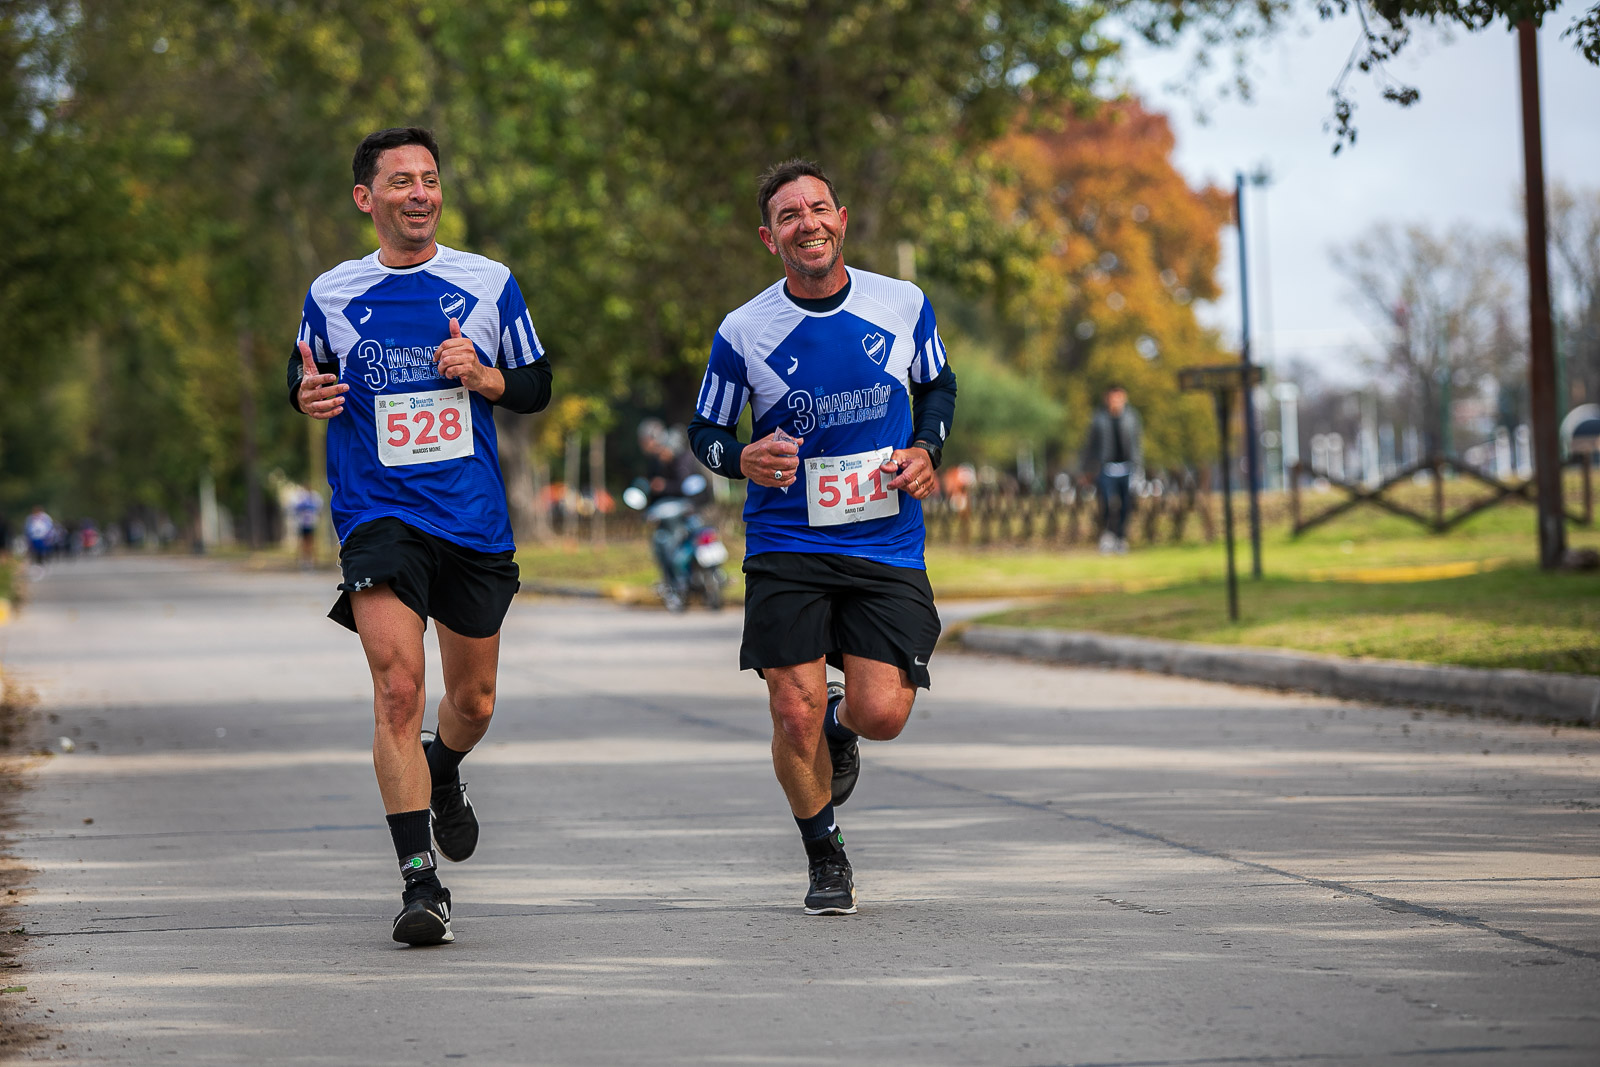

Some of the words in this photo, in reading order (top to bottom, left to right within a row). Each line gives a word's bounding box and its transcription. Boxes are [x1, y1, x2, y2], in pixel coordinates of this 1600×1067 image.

[358, 339, 388, 390] 3
[387, 346, 440, 369] MARA
[410, 397, 416, 409] 3
[788, 390, 815, 435] 3
[816, 383, 891, 415] MARATÓN
[387, 407, 462, 447] 528
[839, 460, 846, 472] 3
[819, 469, 887, 507] 511
